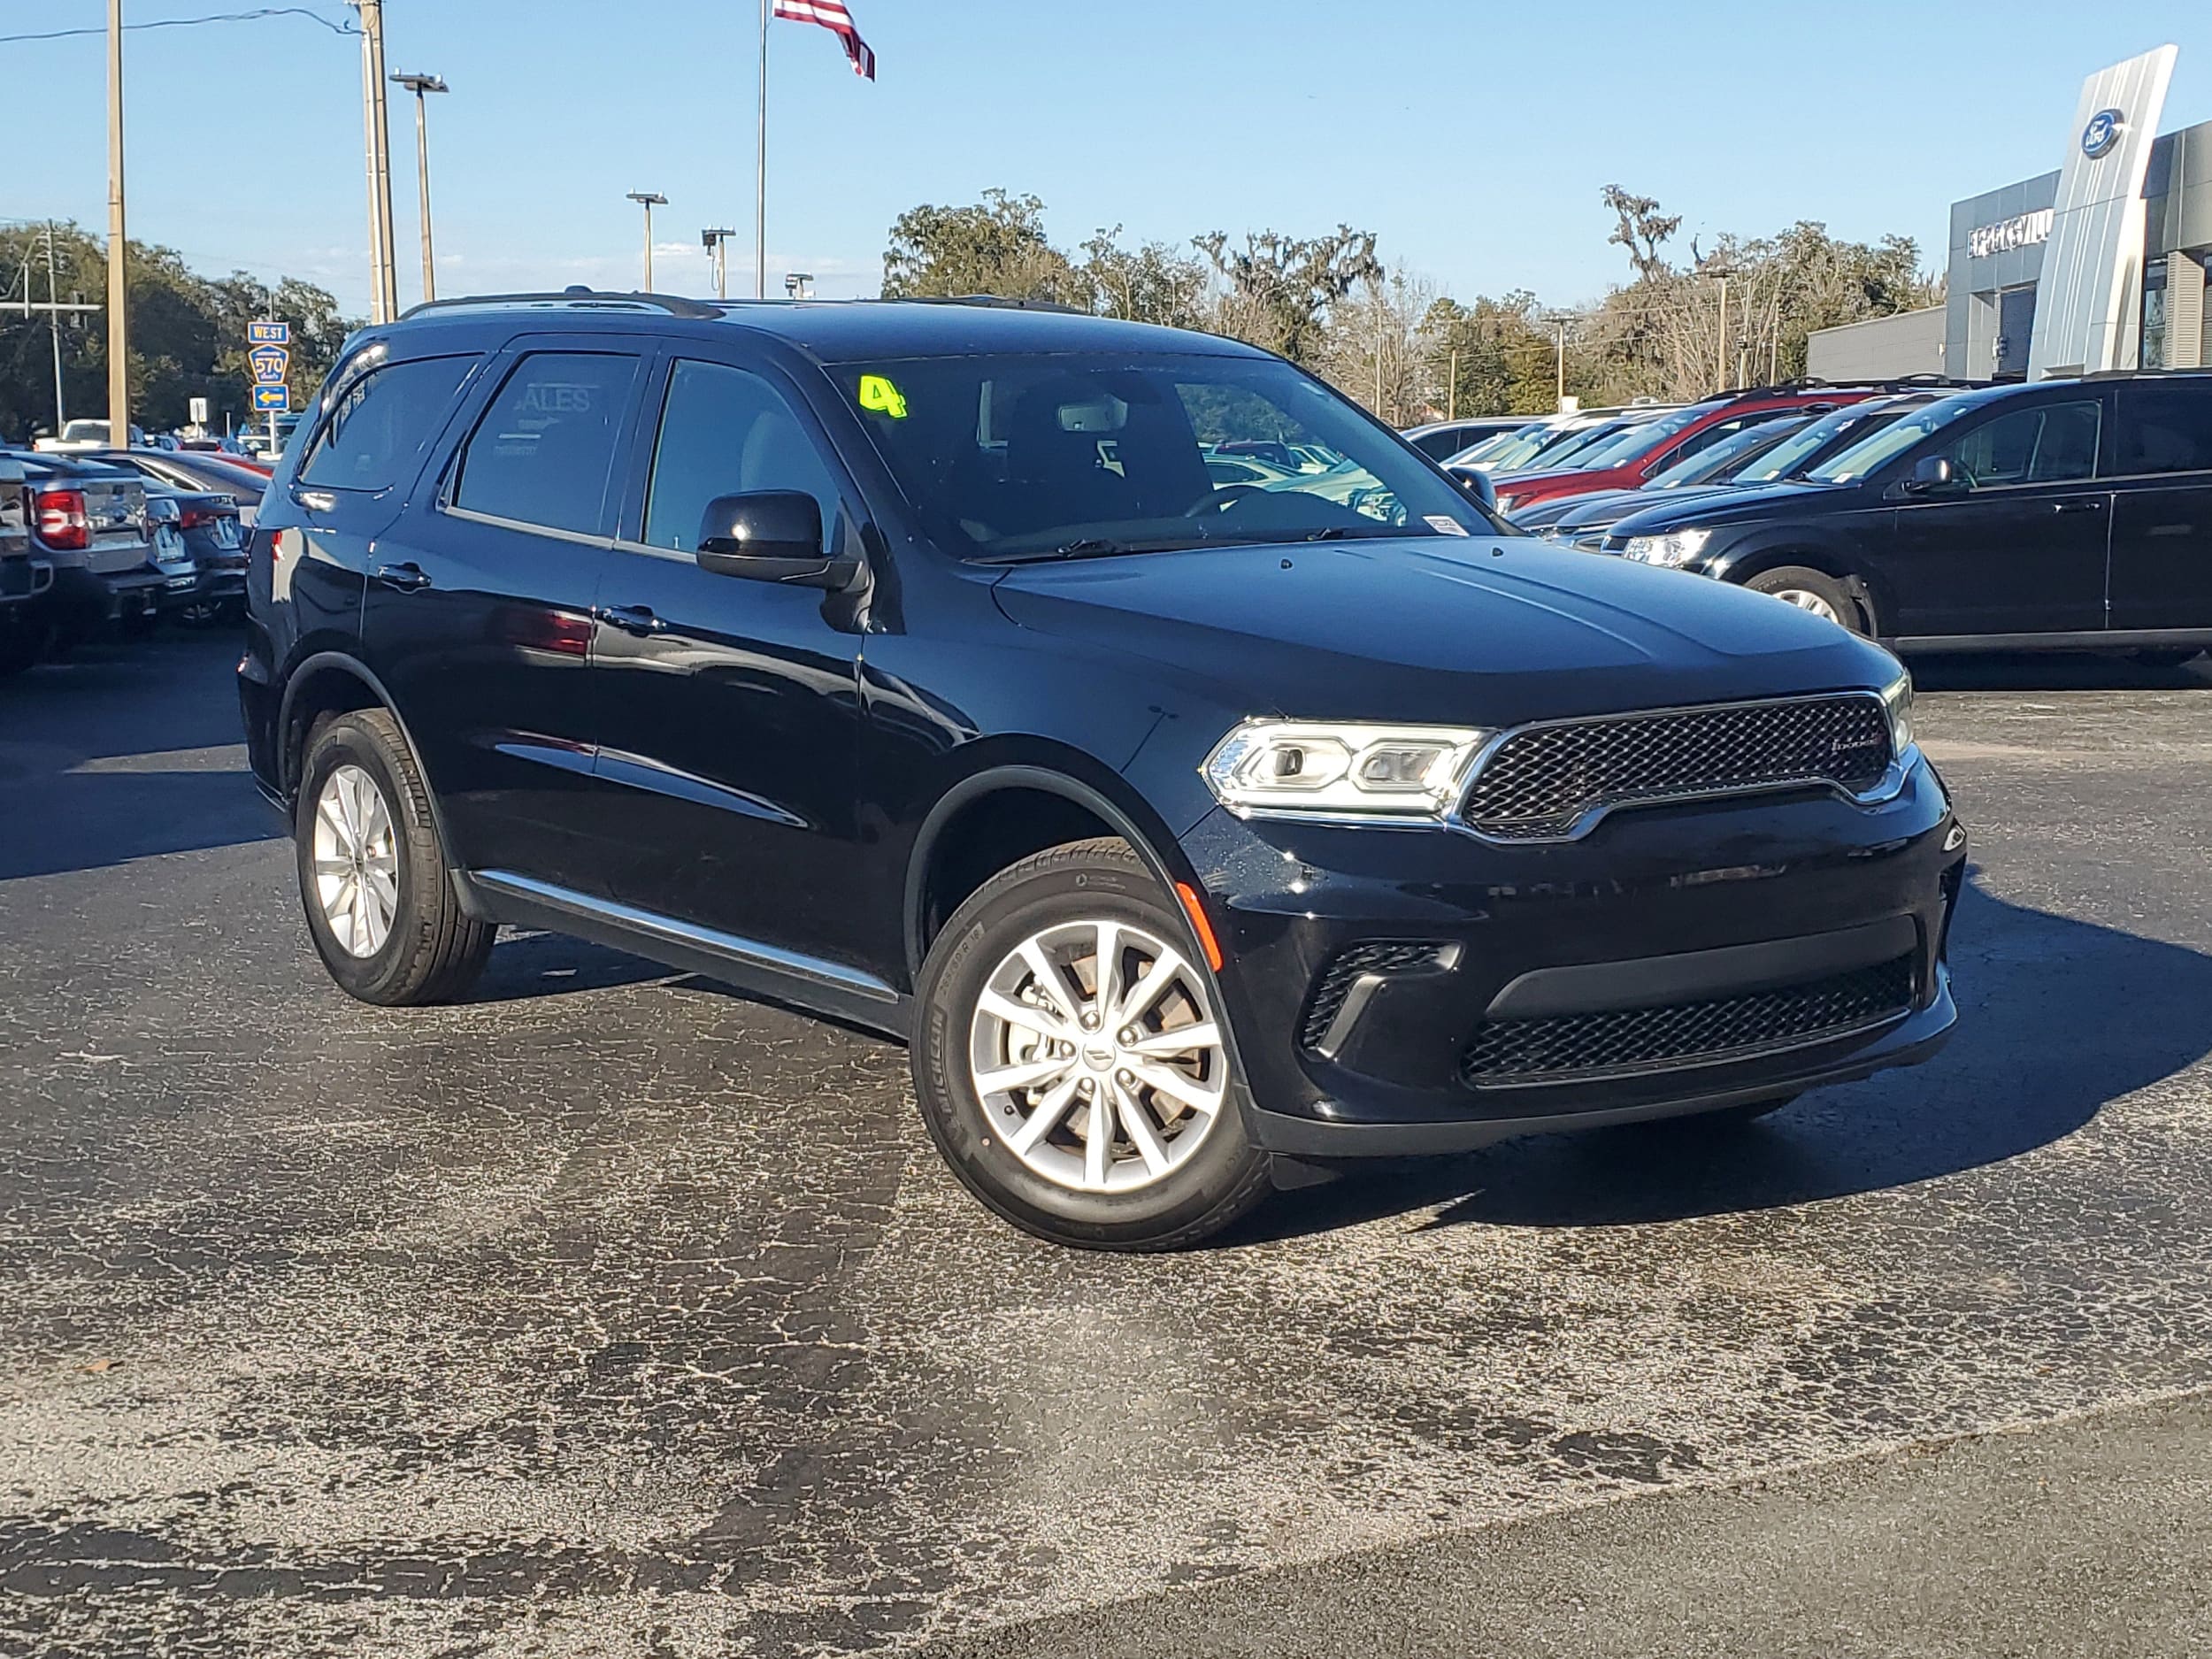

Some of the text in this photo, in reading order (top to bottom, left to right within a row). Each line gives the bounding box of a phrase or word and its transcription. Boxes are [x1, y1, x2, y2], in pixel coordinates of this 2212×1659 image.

[253, 326, 283, 340] WEST
[255, 357, 284, 373] 570
[859, 375, 908, 419] 4
[930, 1011, 953, 1115] MICHELIN
